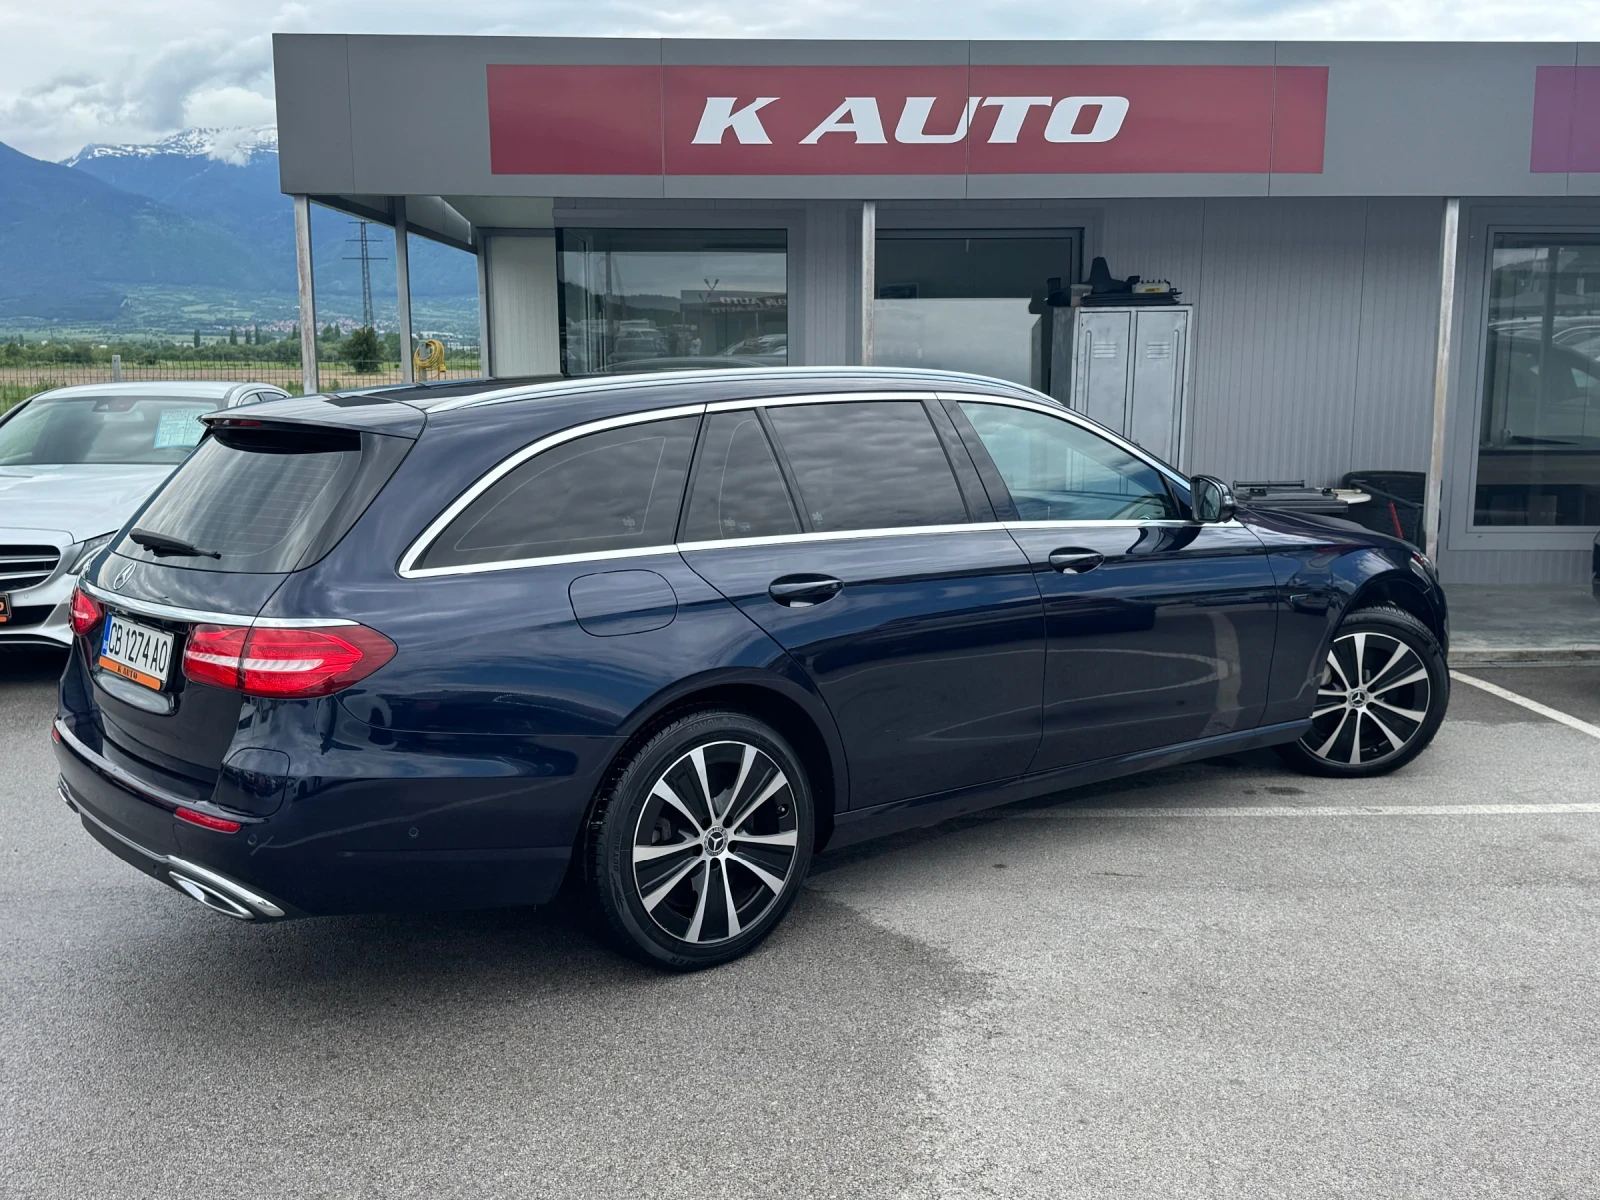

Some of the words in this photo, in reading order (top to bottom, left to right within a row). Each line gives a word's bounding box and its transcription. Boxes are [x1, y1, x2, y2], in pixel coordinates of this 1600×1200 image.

[691, 96, 780, 145] K
[799, 95, 1131, 145] AUTO
[123, 666, 138, 680] AUTO
